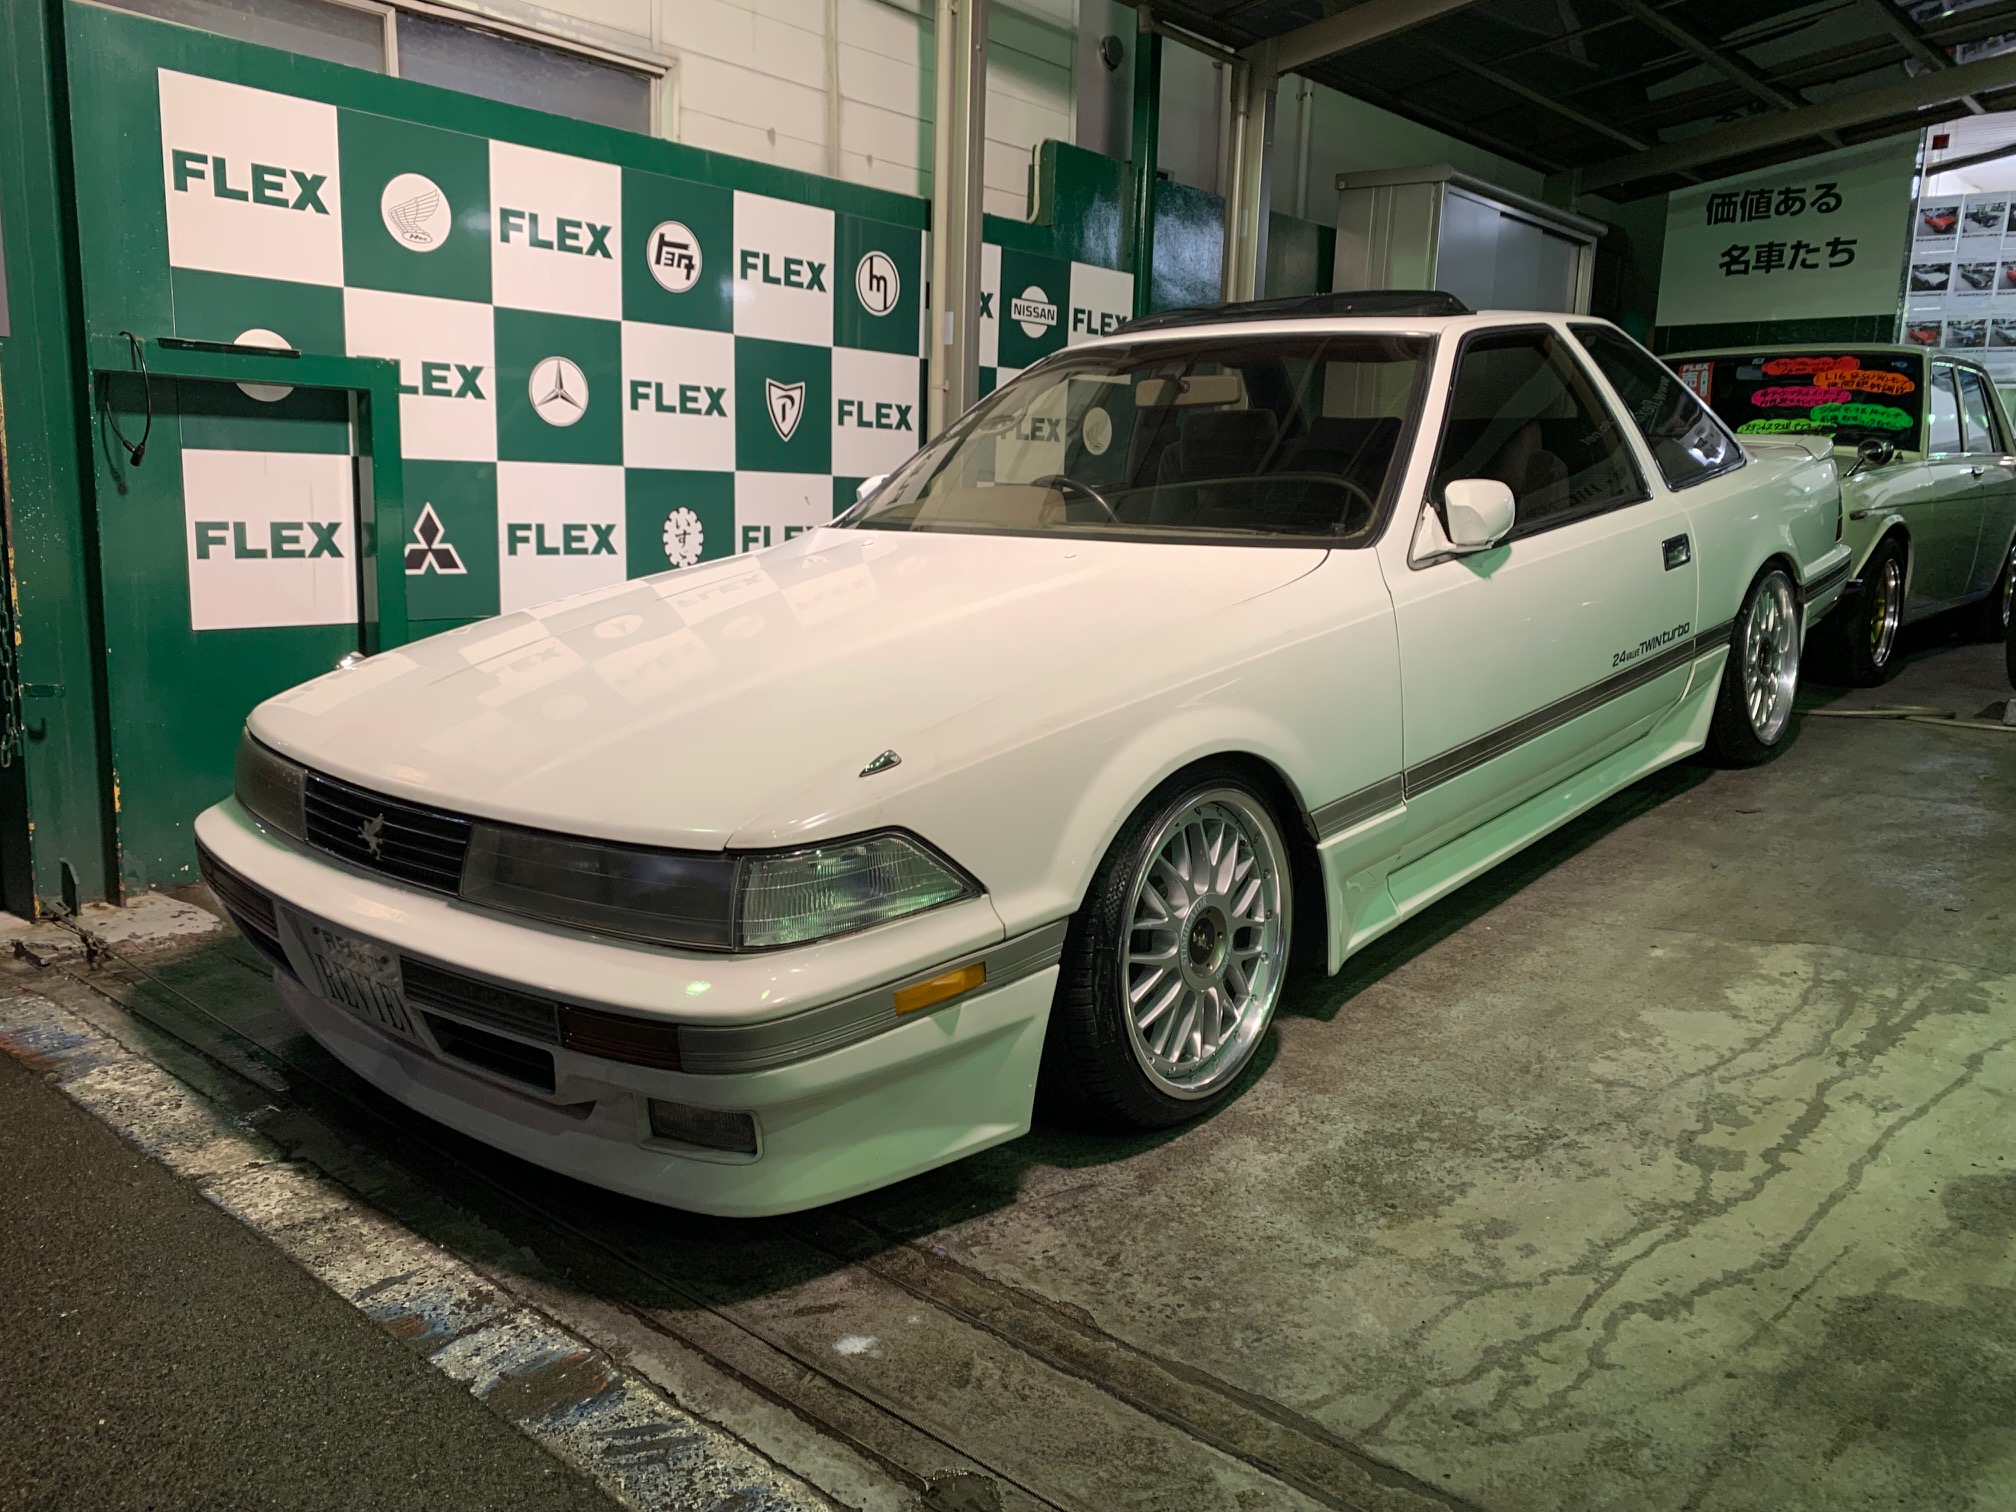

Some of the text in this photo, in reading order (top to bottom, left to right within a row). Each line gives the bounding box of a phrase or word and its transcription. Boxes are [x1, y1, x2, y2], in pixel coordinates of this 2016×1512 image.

[172, 148, 330, 216] FLEX
[1706, 182, 1843, 226] 価値ある
[500, 207, 613, 260] FLEX
[741, 249, 827, 293] FLEX
[1719, 236, 1858, 277] 名車たち
[1013, 302, 1055, 321] NISSAN
[399, 360, 487, 401] EX
[630, 379, 728, 418] FLEX
[838, 398, 913, 432] FLEX
[194, 521, 344, 560] FLEX
[508, 523, 618, 556] FLEX
[742, 525, 813, 553] FLE
